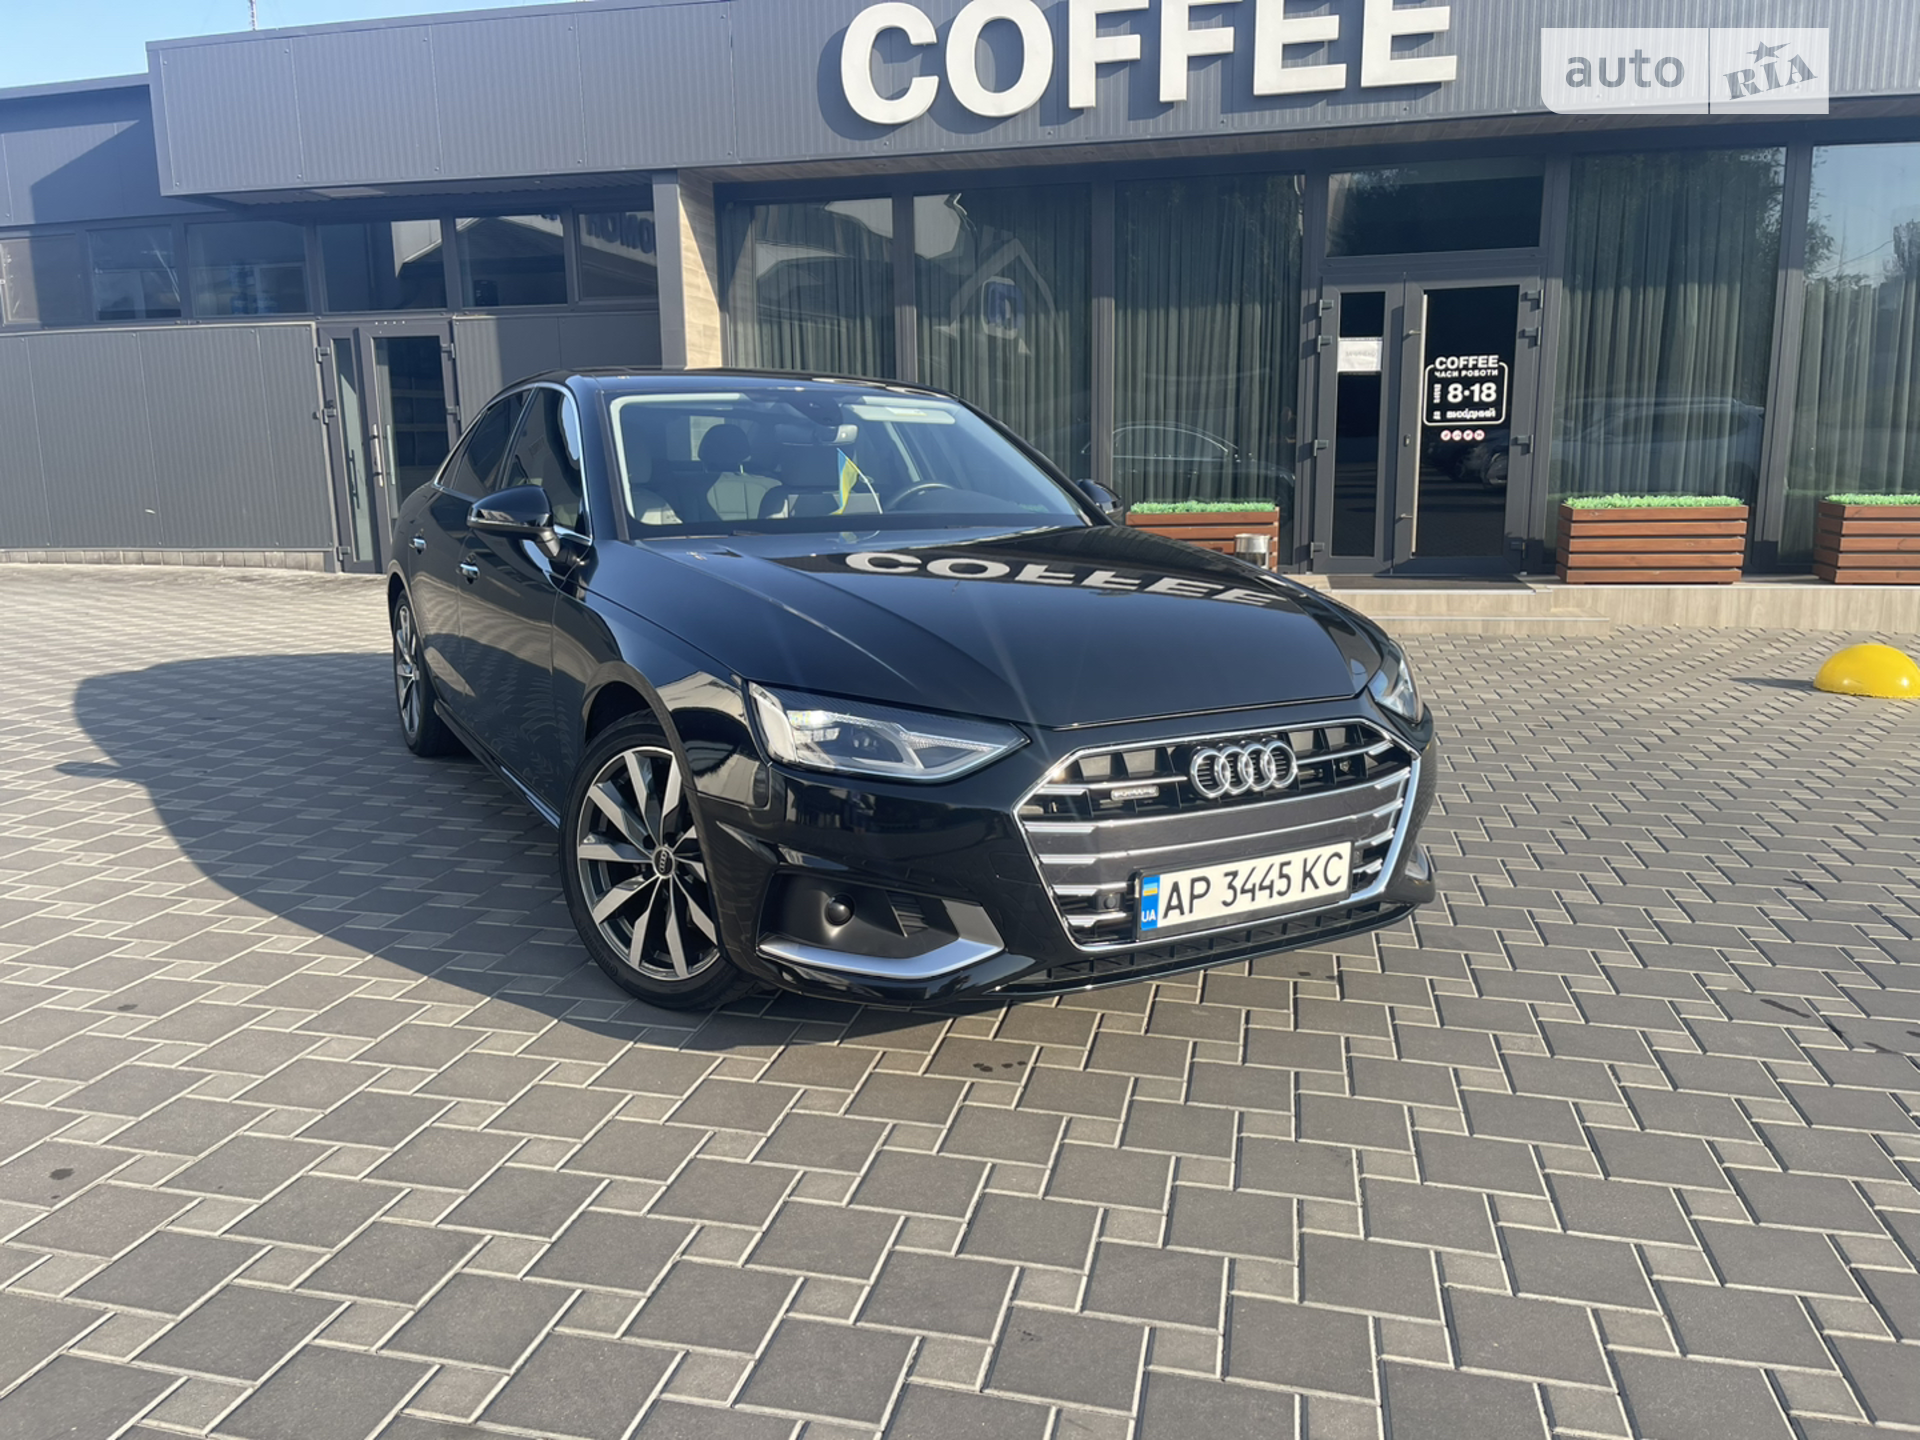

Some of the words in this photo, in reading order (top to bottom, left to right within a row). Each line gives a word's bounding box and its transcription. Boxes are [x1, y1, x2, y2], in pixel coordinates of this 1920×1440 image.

[840, 0, 1457, 124] COFFEE
[1435, 355, 1499, 369] COFFEE
[1434, 370, 1459, 378] ЧАСИ
[1460, 369, 1499, 377] РОБОТИ
[1163, 875, 1211, 918] AP
[1222, 861, 1292, 907] 3445
[1301, 852, 1343, 893] KC
[1141, 910, 1157, 922] UA
